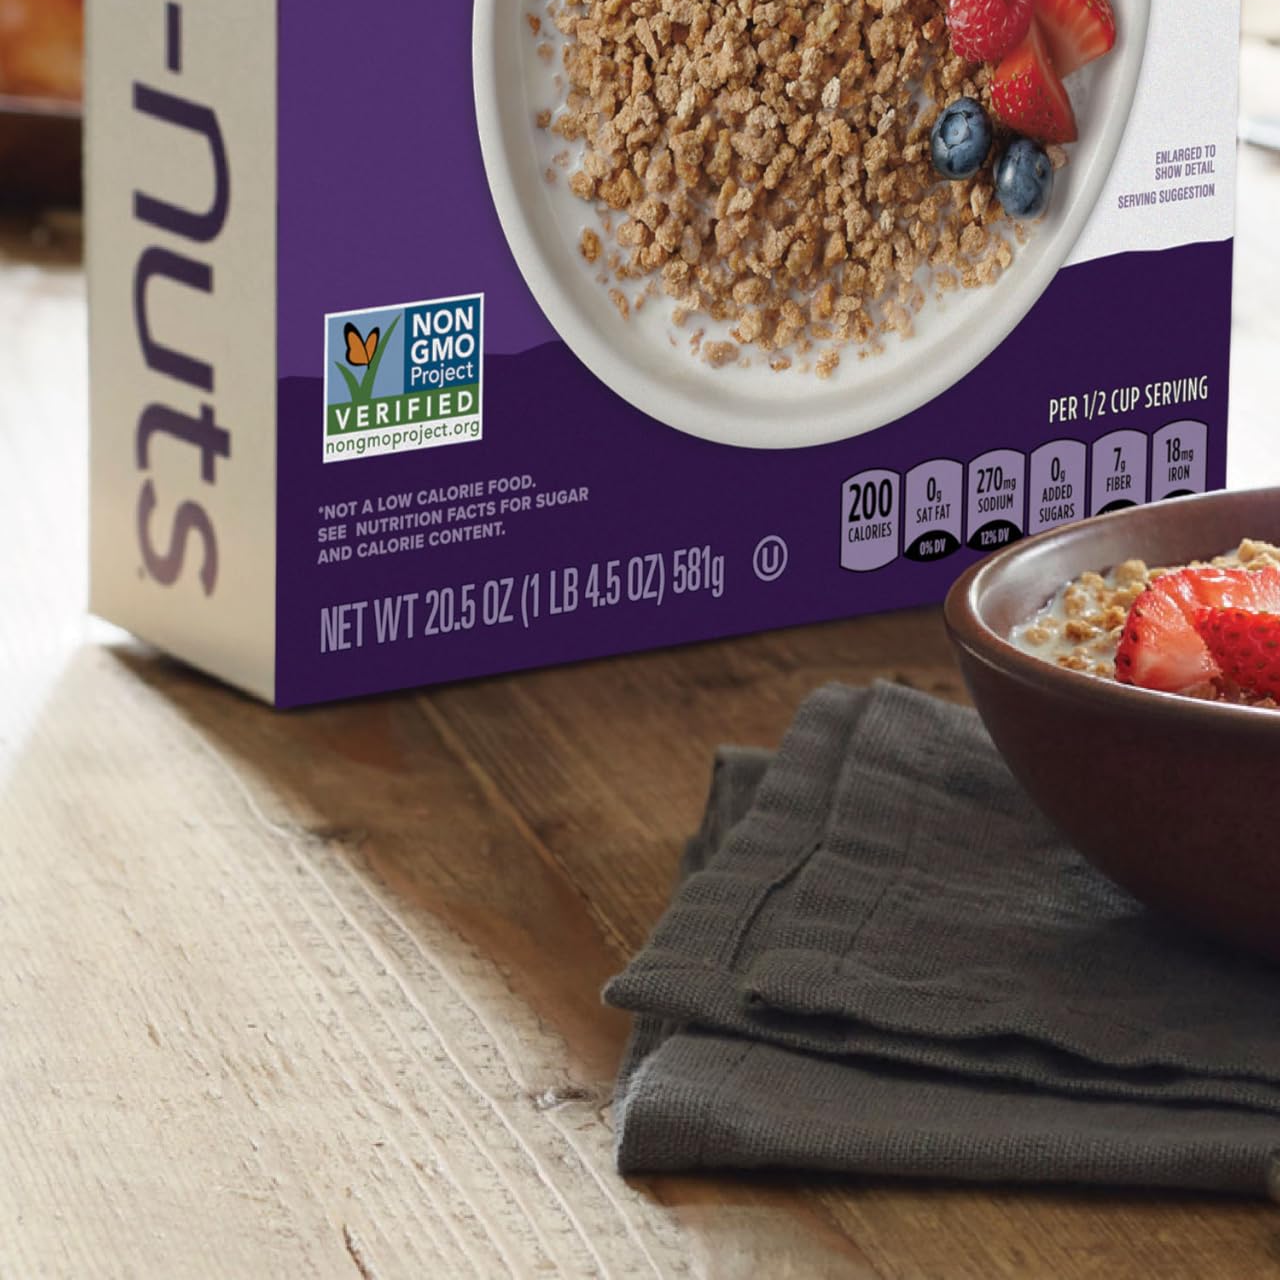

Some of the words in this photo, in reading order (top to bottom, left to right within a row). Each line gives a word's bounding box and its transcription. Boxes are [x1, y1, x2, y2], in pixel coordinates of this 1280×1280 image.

[1156, 146, 1202, 165] ENLARGED
[1205, 144, 1216, 158] TO
[1155, 165, 1182, 180] SHOW
[1185, 160, 1215, 176] DETAIL
[1118, 191, 1156, 209] SERVING
[1159, 183, 1215, 203] SUGGESTION
[412, 305, 474, 337] NON
[411, 333, 475, 364] GMO
[411, 363, 474, 388] Project
[335, 390, 474, 431] VERIFIED
[1049, 396, 1077, 423] PER
[1082, 391, 1106, 422] 1/2
[1111, 386, 1140, 413] CUP
[1145, 375, 1208, 408] SERVING
[325, 418, 480, 455] nongmoproject.org
[1113, 447, 1126, 472] 7g
[1166, 437, 1194, 463] 18mg
[976, 466, 1016, 494] 270mg
[1051, 457, 1065, 483] 0g
[1106, 474, 1132, 492] FIBER
[1168, 465, 1190, 482] IRON
[361, 499, 374, 515] A
[377, 492, 413, 513] LOW
[416, 482, 485, 507] CALORIE
[488, 474, 537, 495] FOOD.
[848, 478, 893, 523] 200
[926, 477, 942, 503] 0g
[1042, 484, 1073, 503] ADDED
[318, 524, 348, 543] SEE
[356, 510, 443, 538] NUTRITION
[447, 502, 497, 523] FACTS
[500, 495, 532, 514] FOR
[536, 487, 590, 510] SUGAR
[916, 506, 933, 524] SAT
[935, 503, 951, 521] FAT
[977, 494, 1014, 513] SODIUM
[1039, 503, 1075, 523] SUGARS
[317, 545, 353, 565] AND
[356, 535, 425, 559] CALORIE
[429, 521, 506, 546] CONTENT.
[848, 522, 892, 543] CALORIES
[980, 530, 997, 546] 12%
[998, 527, 1010, 542] DV
[919, 541, 934, 556] 0%
[934, 538, 946, 553] DV
[320, 601, 369, 653] NET
[374, 593, 419, 644] WT
[424, 584, 476, 636] 20.5
[483, 577, 516, 626] OZ
[521, 574, 540, 628] (1
[549, 567, 580, 615] LB
[585, 561, 621, 607] 4.5
[627, 553, 666, 605] OZ)
[672, 544, 726, 598] 581g
